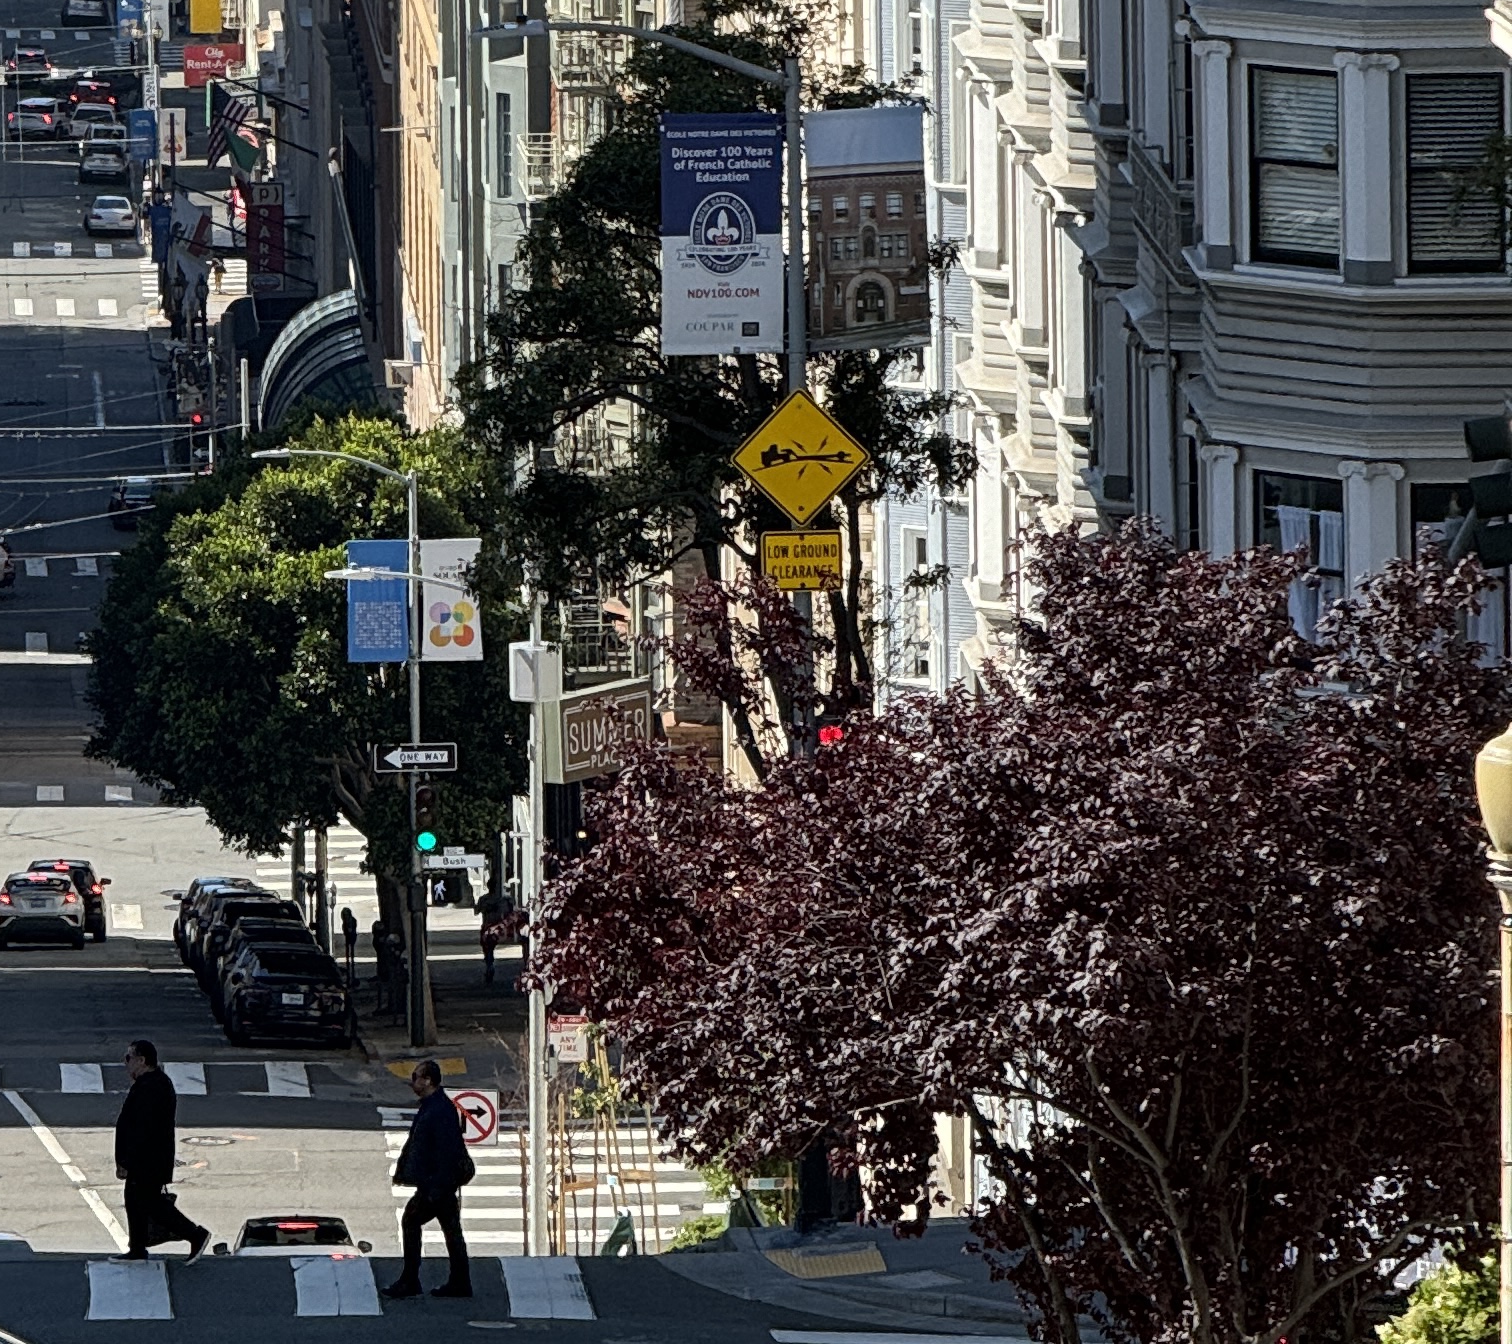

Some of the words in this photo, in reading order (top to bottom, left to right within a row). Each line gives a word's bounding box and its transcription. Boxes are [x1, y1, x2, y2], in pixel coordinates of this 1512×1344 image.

[671, 147, 718, 158] Discover
[720, 146, 742, 157] 100
[744, 146, 774, 157] Years
[674, 160, 686, 171] of
[688, 160, 725, 170] French
[727, 158, 772, 169] Catholic
[696, 172, 750, 183] Education
[688, 288, 760, 299] NDV100.COM
[768, 545, 790, 559] LOW
[793, 543, 838, 558] GROUND
[399, 752, 420, 762] ONE
[424, 752, 445, 761] WAY
[442, 856, 466, 865] Bush
